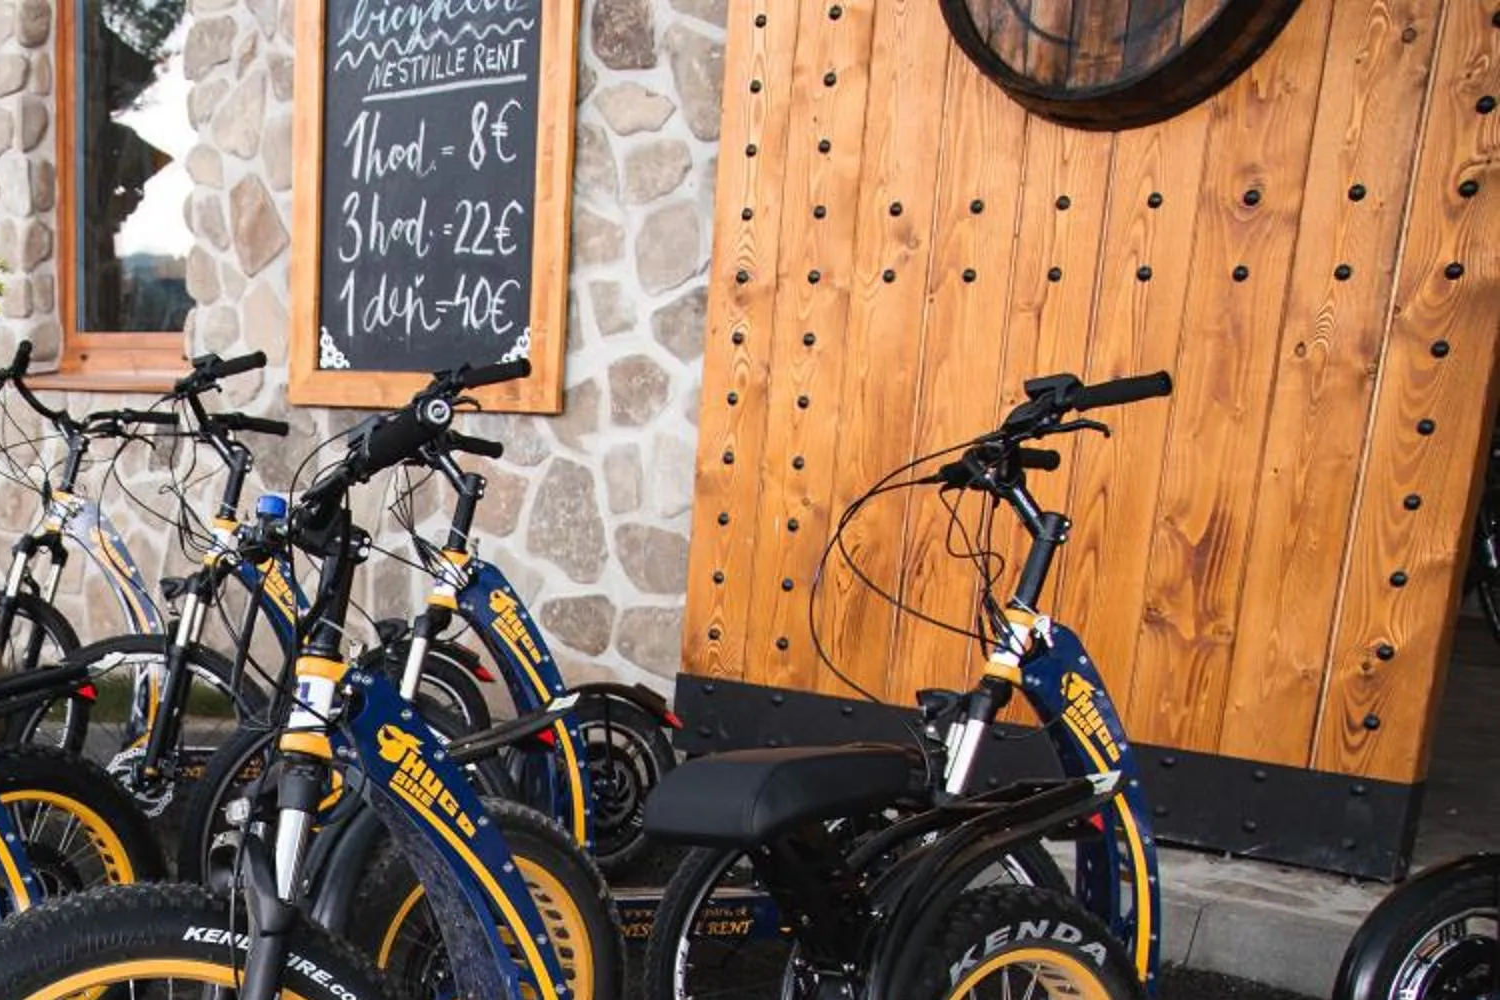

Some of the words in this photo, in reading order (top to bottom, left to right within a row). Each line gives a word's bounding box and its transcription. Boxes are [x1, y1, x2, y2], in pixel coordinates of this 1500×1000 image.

[366, 47, 467, 91] NESTVILLE
[473, 38, 527, 74] RENT
[1073, 693, 1120, 762] HUGO
[400, 750, 477, 838] HUGO
[949, 919, 1108, 987] KENDA
